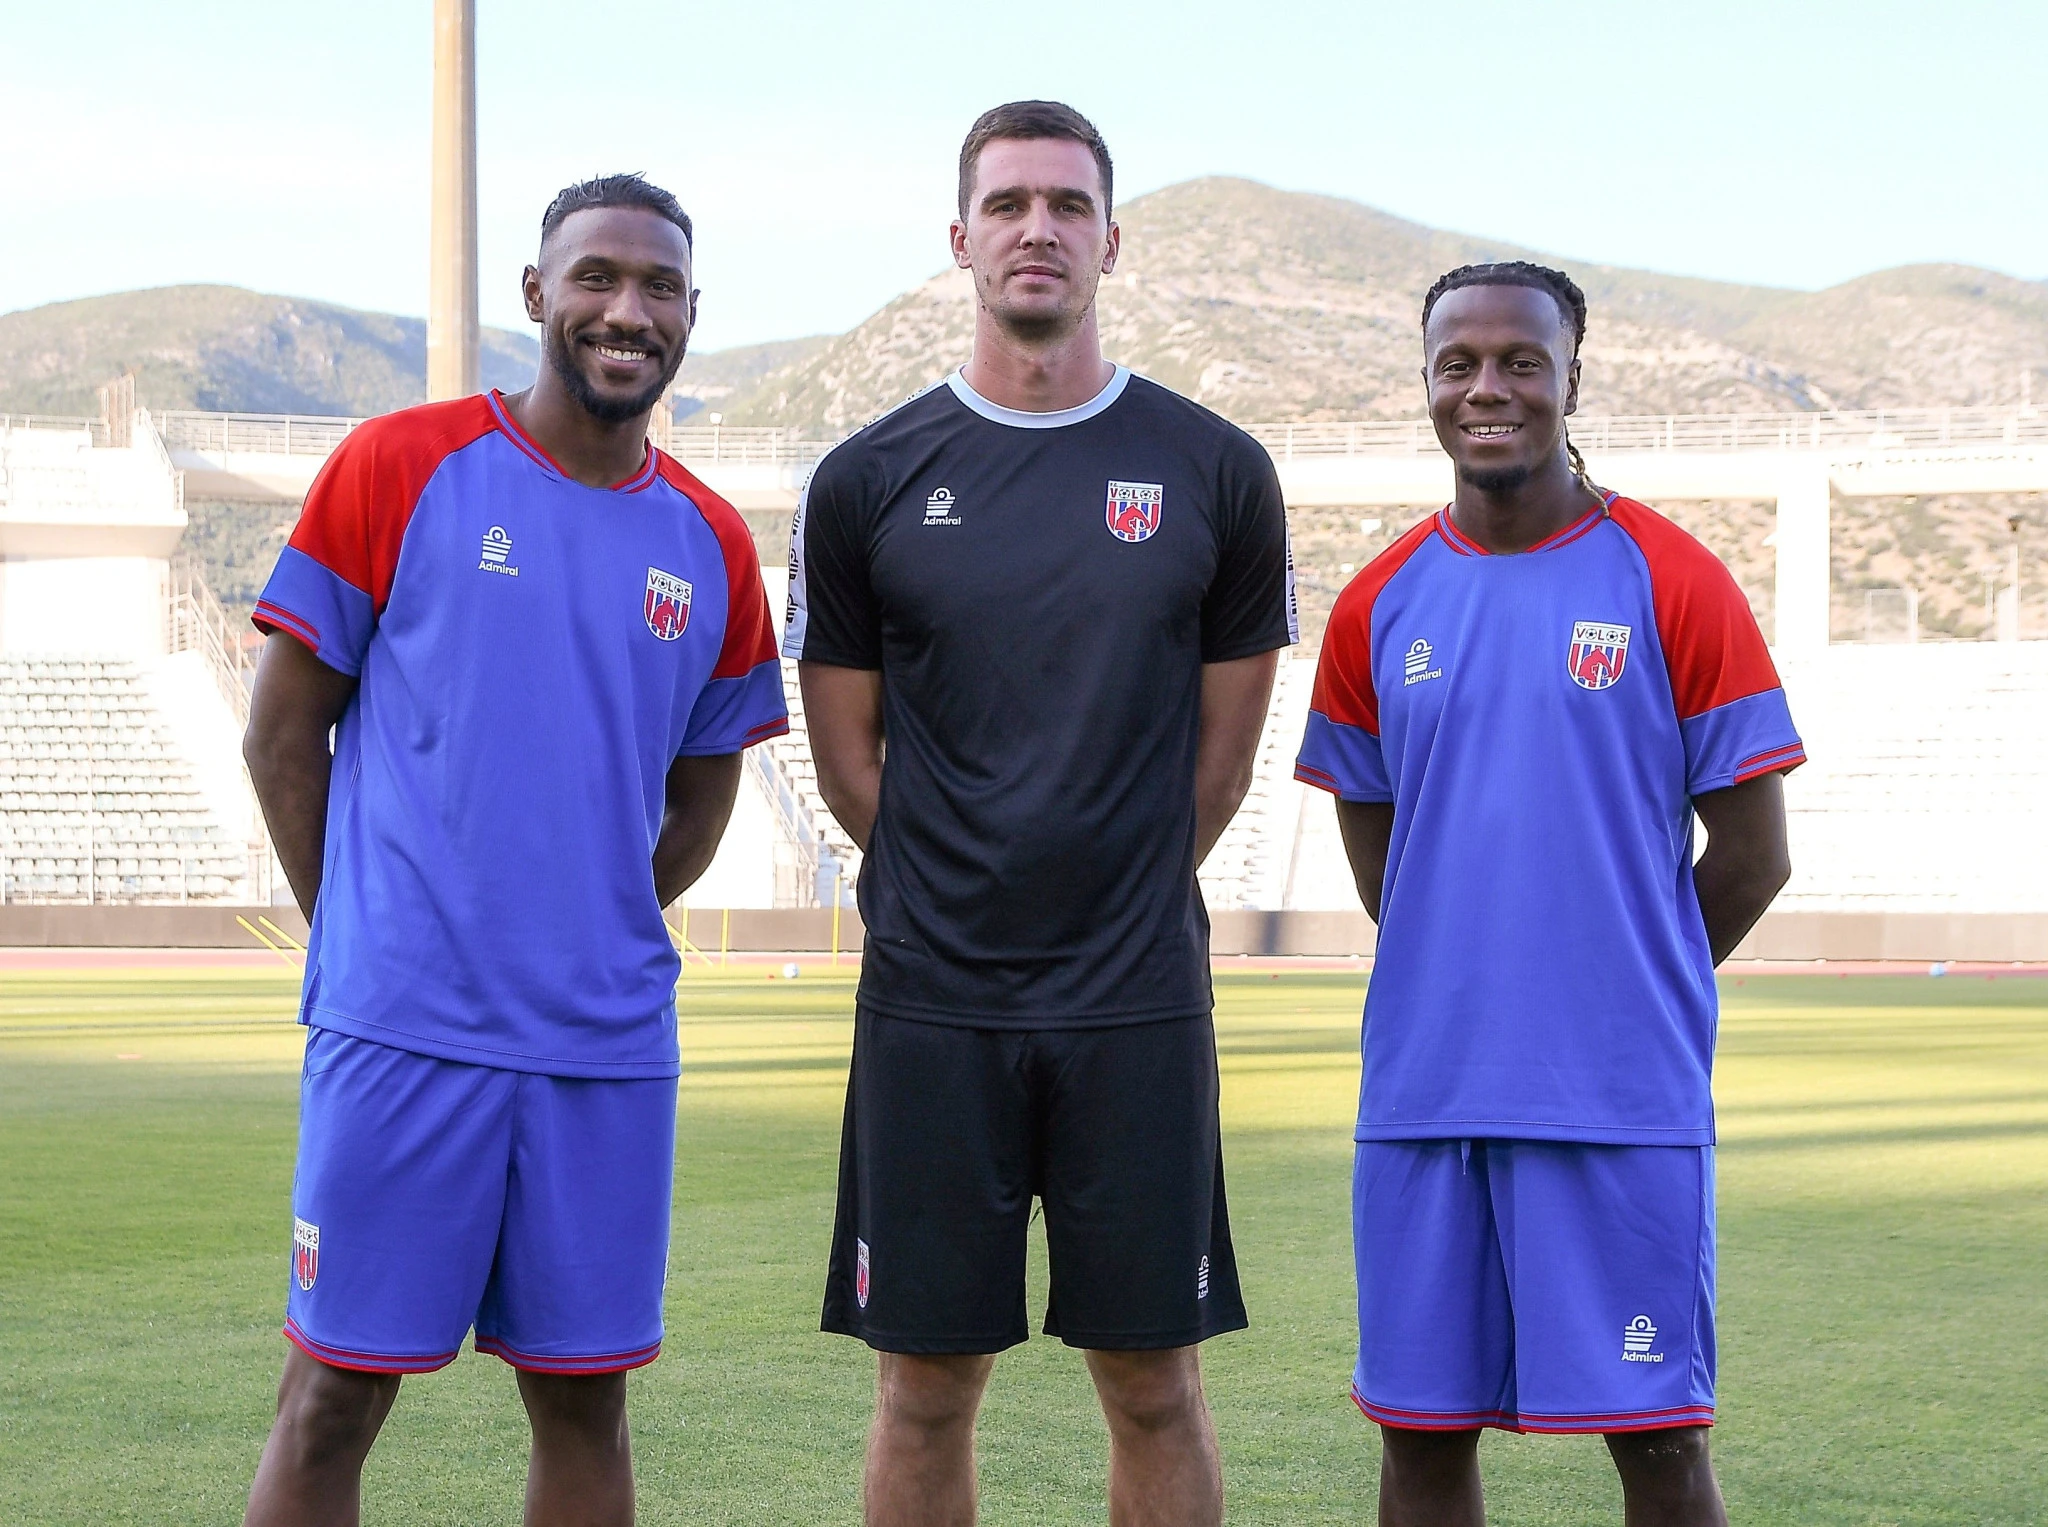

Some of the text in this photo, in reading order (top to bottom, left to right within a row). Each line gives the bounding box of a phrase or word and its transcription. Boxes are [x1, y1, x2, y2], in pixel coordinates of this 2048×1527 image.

[1110, 487, 1161, 501] VOLOS
[922, 516, 962, 526] Admiral
[478, 560, 519, 577] Admiral
[650, 573, 690, 599] VOLOS
[1576, 627, 1627, 643] VOLOS
[1404, 667, 1442, 687] Admiral
[1621, 1350, 1664, 1362] Admiral
